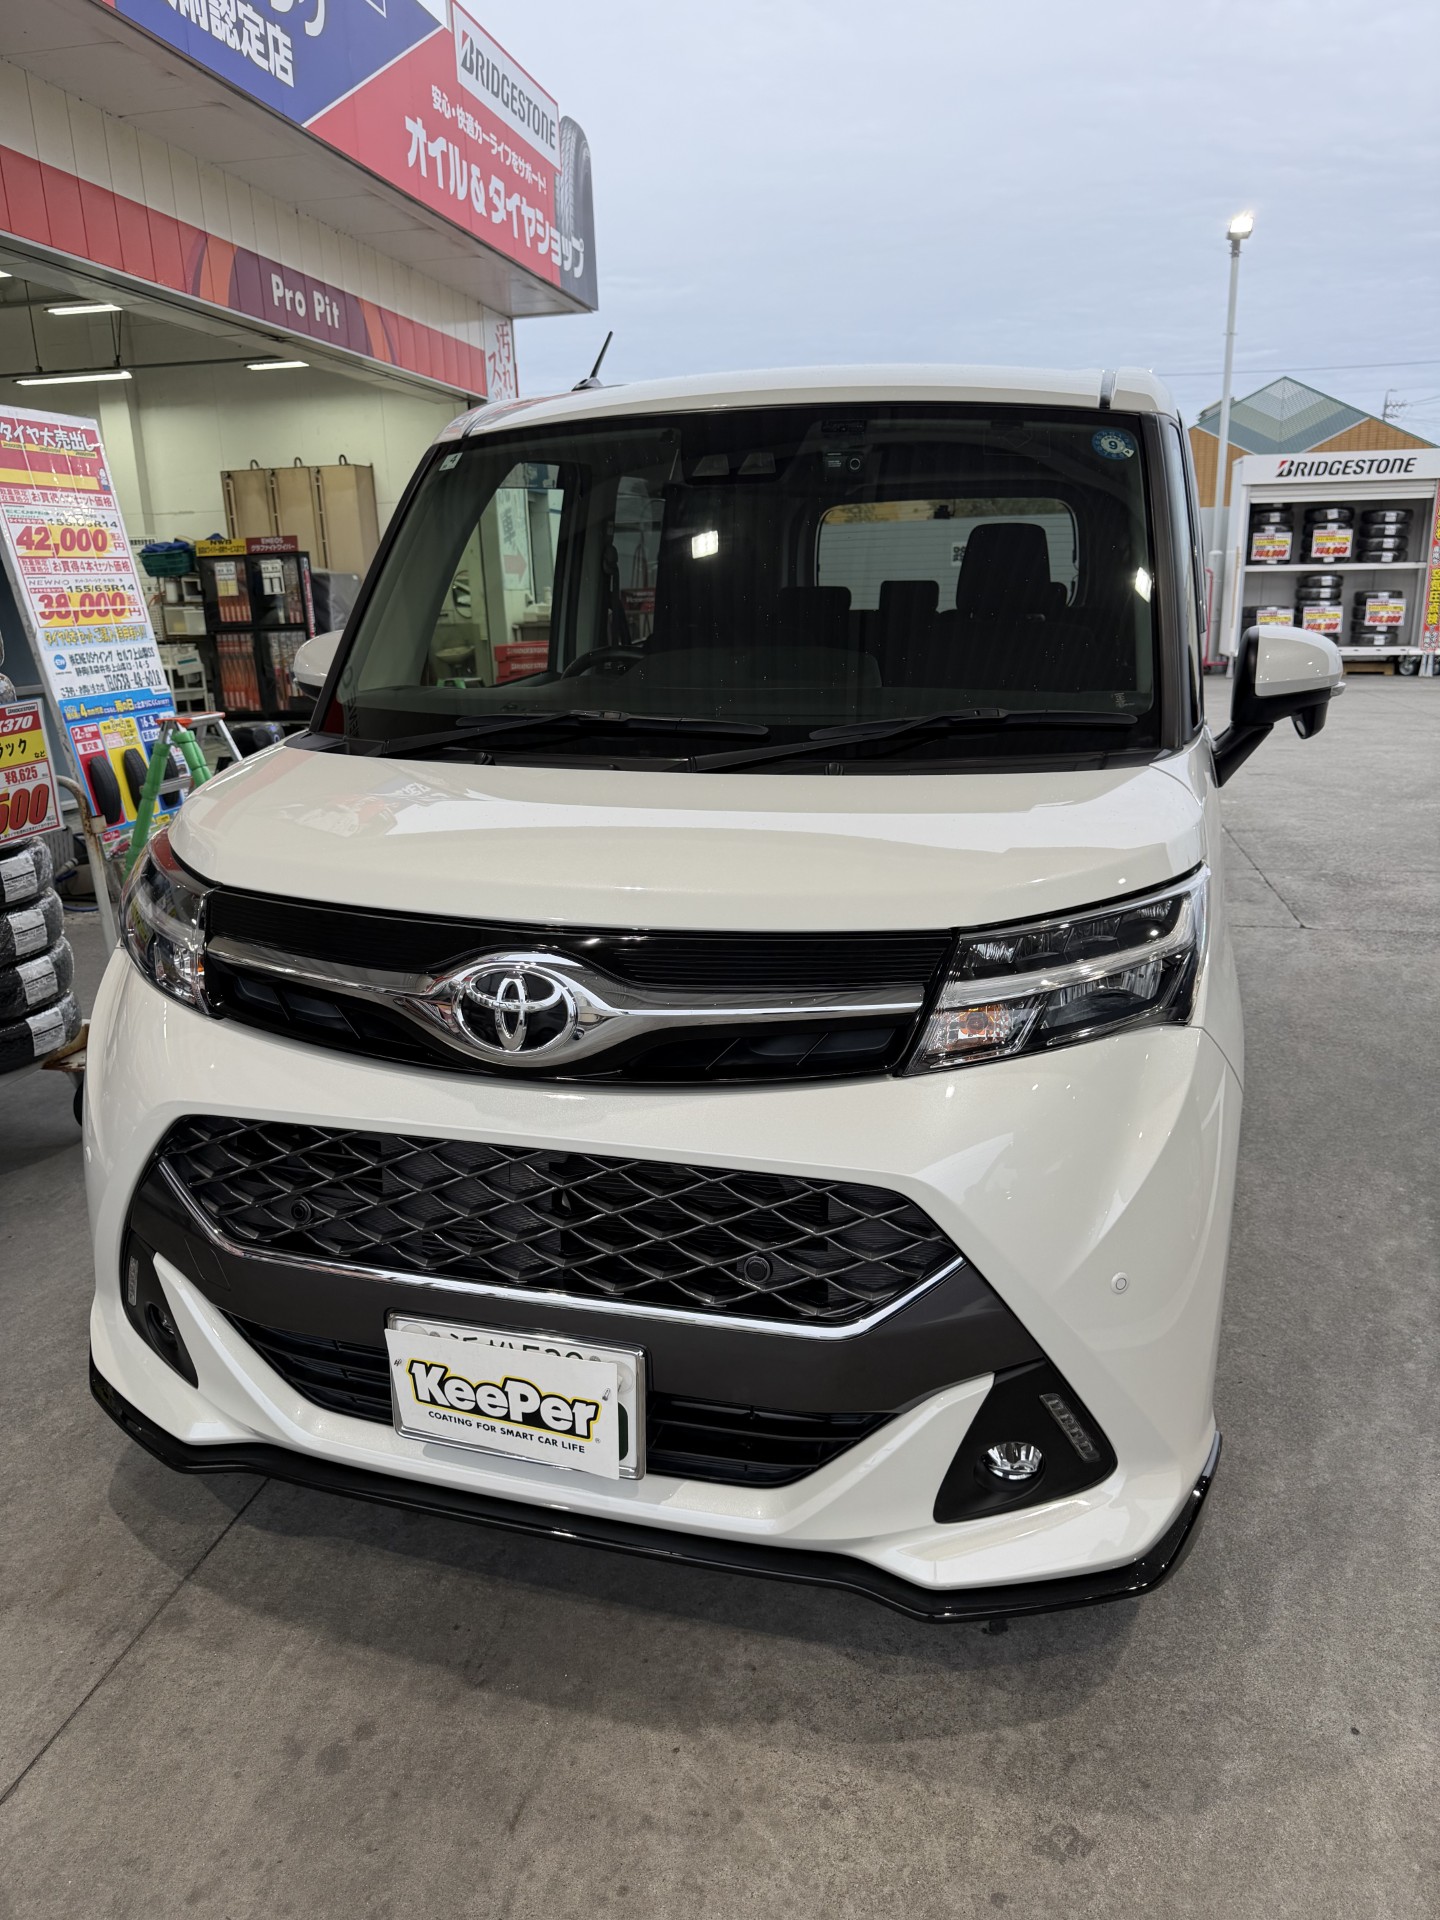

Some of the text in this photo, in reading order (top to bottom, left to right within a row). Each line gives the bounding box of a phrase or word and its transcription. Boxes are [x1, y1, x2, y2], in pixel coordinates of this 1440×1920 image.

[460, 30, 556, 151] BRIDGESTONE
[404, 115, 585, 278] オイル&タイヤショップ
[271, 273, 341, 330] Pro Pit
[0, 421, 95, 452] タイヤ大売出し
[1276, 457, 1418, 478] BRIDGESTONE
[16, 525, 108, 556] 42,000
[66, 584, 135, 593] 155/65R14
[38, 591, 126, 625] 38,000
[34, 750, 46, 759] など
[4, 766, 38, 785] ¥8,625
[406, 1358, 603, 1442] KeePer
[428, 1410, 586, 1453] COATING FOR SMART CAR LIFE
